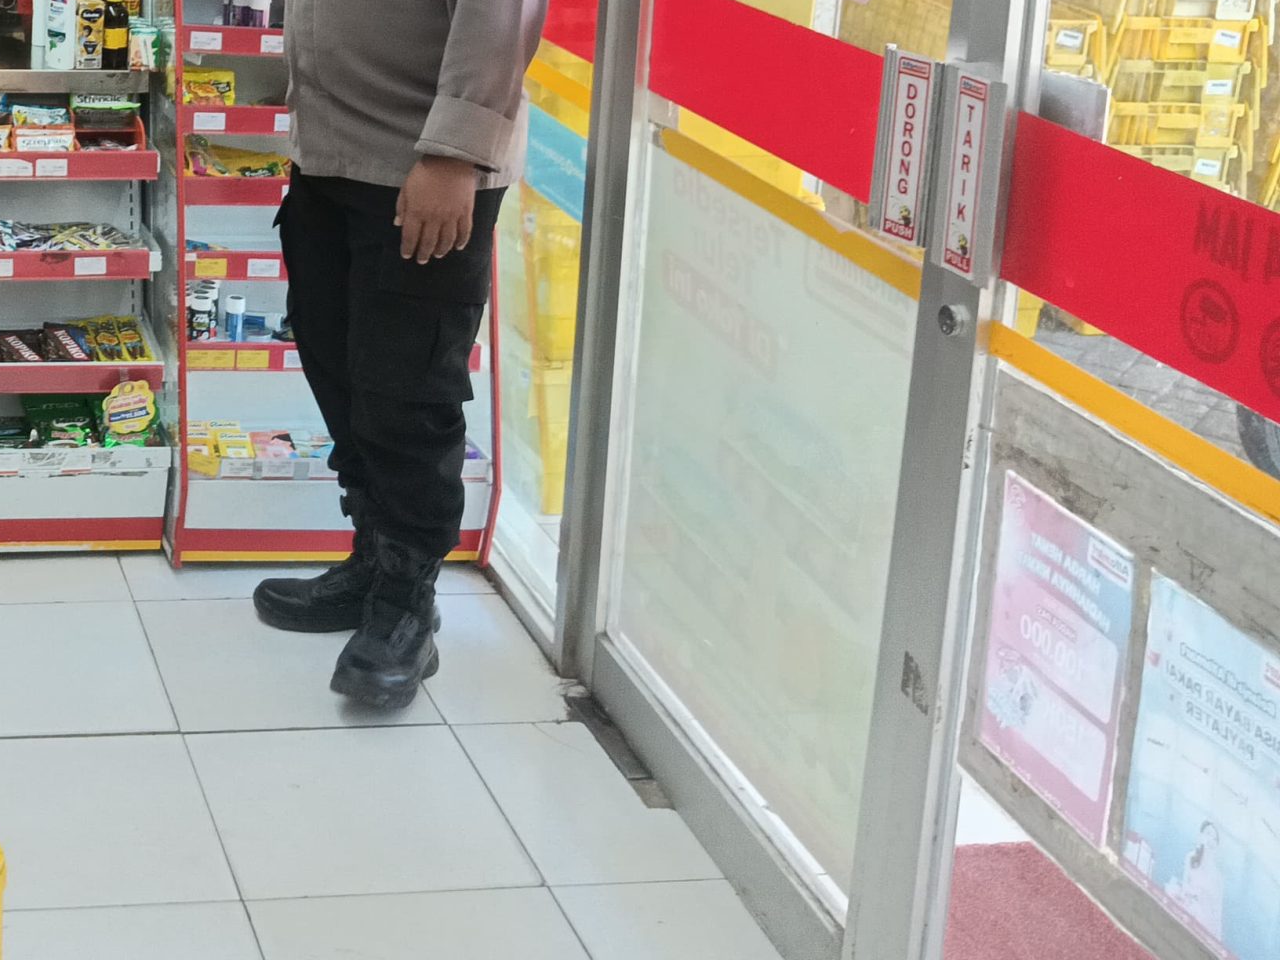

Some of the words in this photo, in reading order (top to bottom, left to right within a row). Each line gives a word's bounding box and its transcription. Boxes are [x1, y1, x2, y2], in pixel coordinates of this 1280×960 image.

[897, 82, 919, 196] DORONG
[956, 103, 976, 223] TARIK
[884, 219, 914, 240] PUSH
[945, 249, 970, 270] PULL
[6, 335, 41, 362] KOPIKO
[54, 329, 87, 360] KOPIKO
